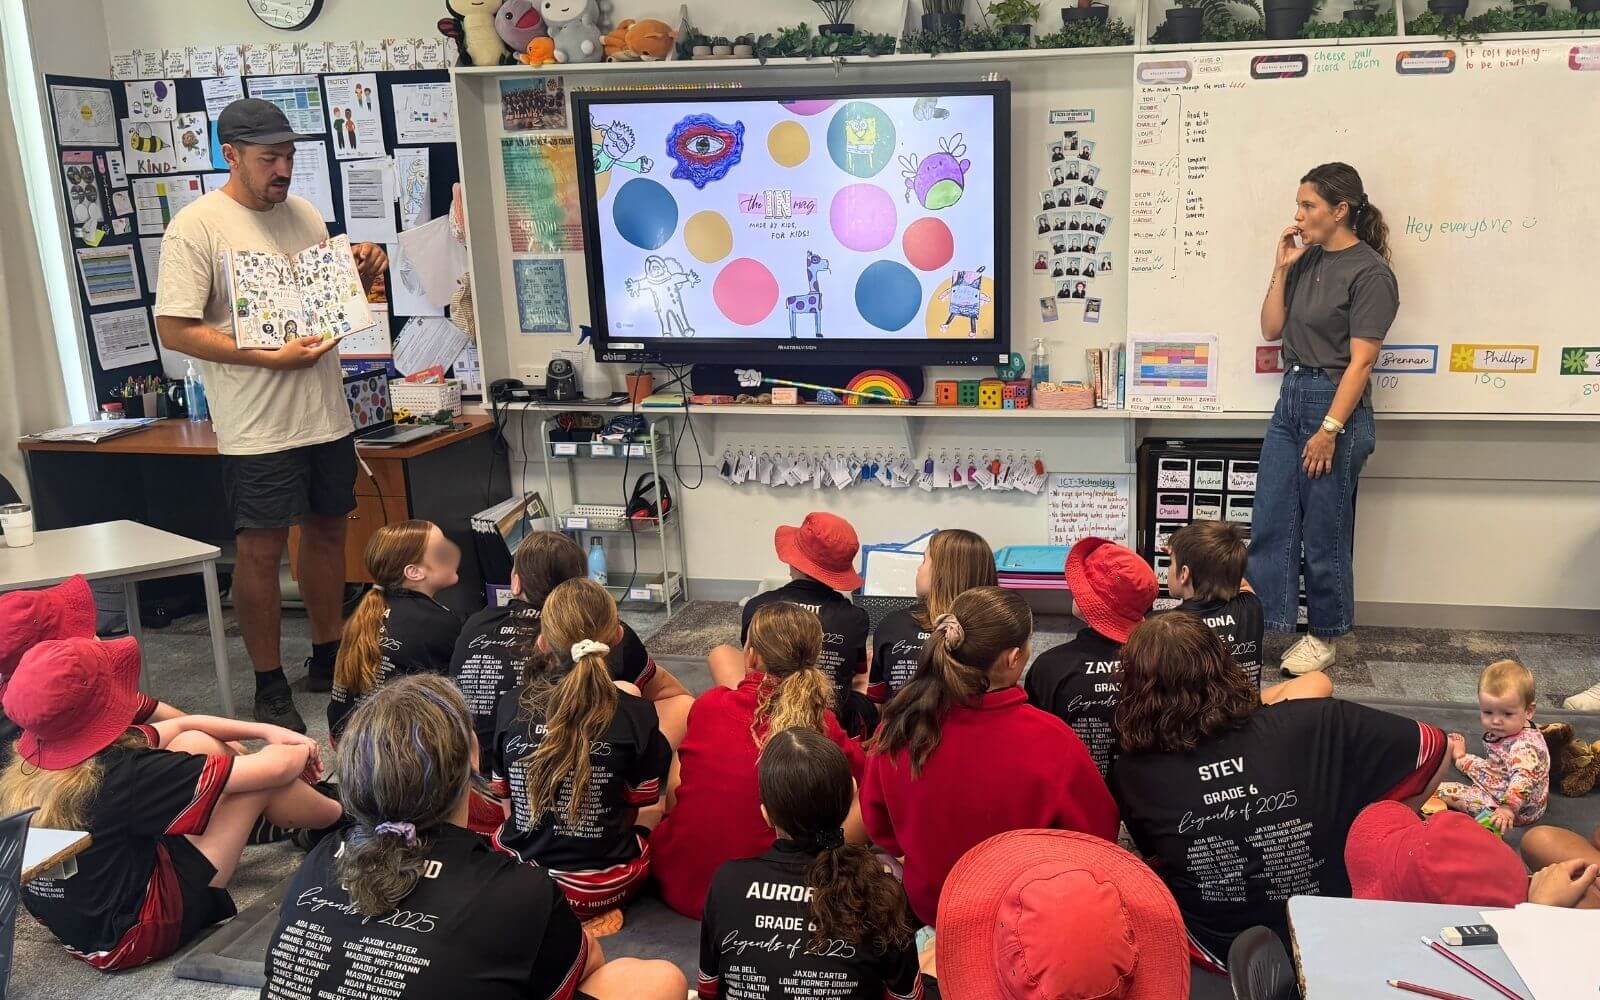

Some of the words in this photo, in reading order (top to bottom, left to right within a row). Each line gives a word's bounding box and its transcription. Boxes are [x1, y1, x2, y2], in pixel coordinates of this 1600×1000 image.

[272, 9, 278, 21] 7
[284, 12, 292, 23] 6
[297, 7, 304, 18] 5
[1314, 50, 1346, 61] cheese
[740, 193, 762, 211] the
[763, 190, 792, 219] IN
[794, 200, 815, 215] mag
[790, 230, 810, 238] KIDS!
[1406, 216, 1432, 242] Hey
[1440, 216, 1512, 238] everyone
[1382, 352, 1428, 366] Brennan
[1484, 350, 1527, 370] Phillips
[1376, 376, 1398, 388] 100
[1060, 478, 1114, 489] ICT-Technology
[468, 634, 516, 649] Legends
[822, 632, 844, 644] 025
[892, 639, 923, 654] Legen
[1231, 641, 1256, 655] 2025
[1086, 661, 1124, 674] ZAYD
[1094, 683, 1122, 692] GRAD
[1068, 694, 1118, 712] Legends
[506, 735, 542, 754] Legen
[1198, 756, 1245, 782] STEV
[1203, 786, 1246, 806] GRADE
[1249, 784, 1259, 796] 6
[1178, 805, 1238, 834] Legends
[1240, 802, 1252, 822] of
[1256, 790, 1298, 815] 2025
[1255, 825, 1276, 834] JAXON
[1277, 818, 1301, 829] CARTER
[1252, 839, 1277, 847] MADDIE
[1262, 851, 1285, 860] MASON
[1287, 846, 1310, 855] DECKER
[746, 880, 817, 903] AUROR
[297, 886, 358, 916] Legends
[588, 890, 626, 908] HONESTY
[296, 920, 308, 928] ADA
[309, 923, 325, 934] BELL
[377, 908, 441, 933] 2025
[755, 914, 804, 932] GRADE
[808, 918, 817, 932] 6
[306, 932, 332, 944] CUENTO
[721, 930, 784, 956] Legends
[786, 938, 801, 960] of
[803, 938, 856, 958] 2025
[305, 940, 332, 953] RALTON
[359, 936, 384, 948] JAXON
[385, 942, 418, 955] CARTER
[299, 948, 324, 961] O'NEILL
[342, 941, 364, 952] LOUIE
[364, 945, 431, 967] HORNER-DODSON
[298, 957, 331, 971] NEIVANDT
[344, 950, 373, 964] MADDIE
[374, 958, 420, 974] HOFFMANN
[294, 965, 320, 978] MILLER
[352, 961, 379, 974] MADDY
[380, 968, 405, 980] LIBON
[792, 970, 817, 978] JAXON
[819, 971, 848, 980] CARTER
[293, 973, 314, 985] SMITH
[346, 969, 373, 982] MASON
[373, 977, 406, 990] DECKER
[742, 974, 767, 983] CUENTO
[778, 977, 799, 986] LOUIE
[280, 988, 311, 1000] HAMMOND
[286, 980, 313, 994] MCLEAN
[337, 986, 368, 1000] REEGAN
[344, 978, 365, 990] NOAH
[366, 985, 401, 998] BENBOW
[746, 983, 770, 992] RALTON
[784, 986, 811, 995] MADDIE
